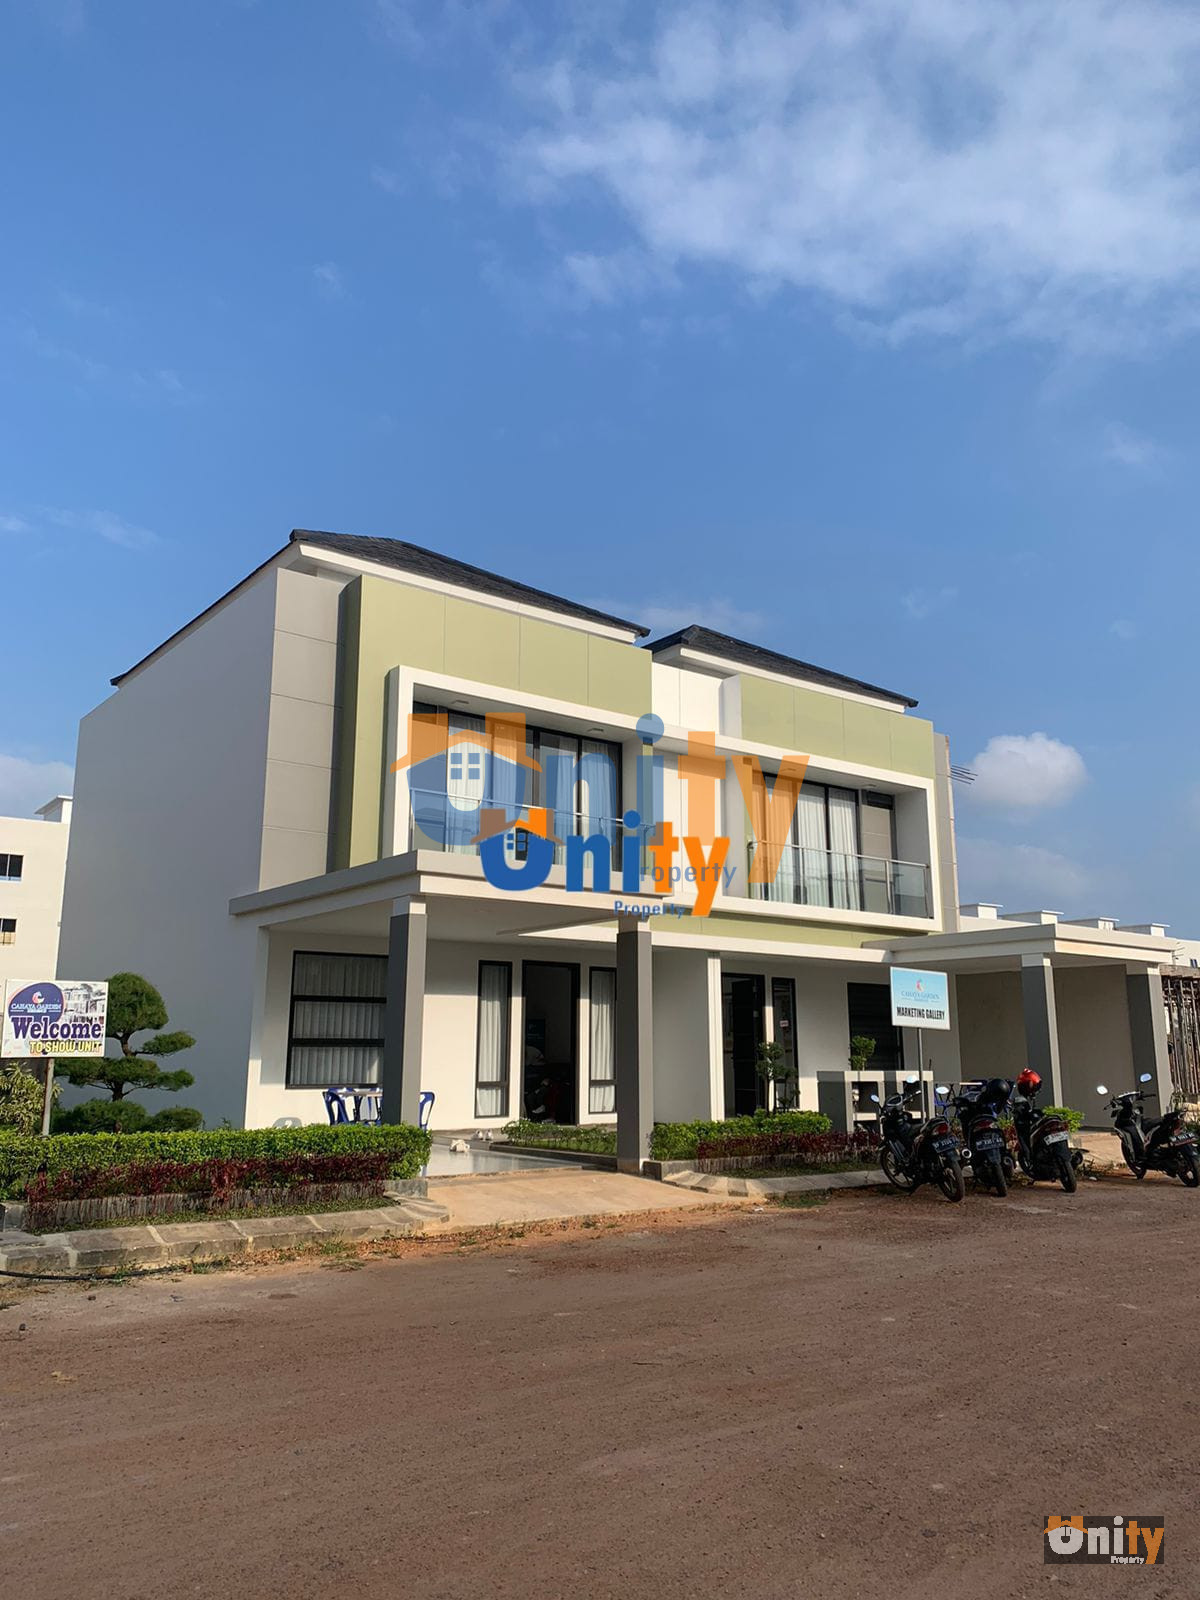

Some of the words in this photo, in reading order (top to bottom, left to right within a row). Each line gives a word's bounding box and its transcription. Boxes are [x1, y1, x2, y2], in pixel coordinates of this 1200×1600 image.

[896, 1007, 925, 1019] MARKETING
[926, 1009, 945, 1020] GALLERY
[11, 1017, 102, 1039] Welcome
[29, 1041, 43, 1053] TO
[45, 1041, 76, 1053] SHOW
[78, 1041, 101, 1053] UNIT
